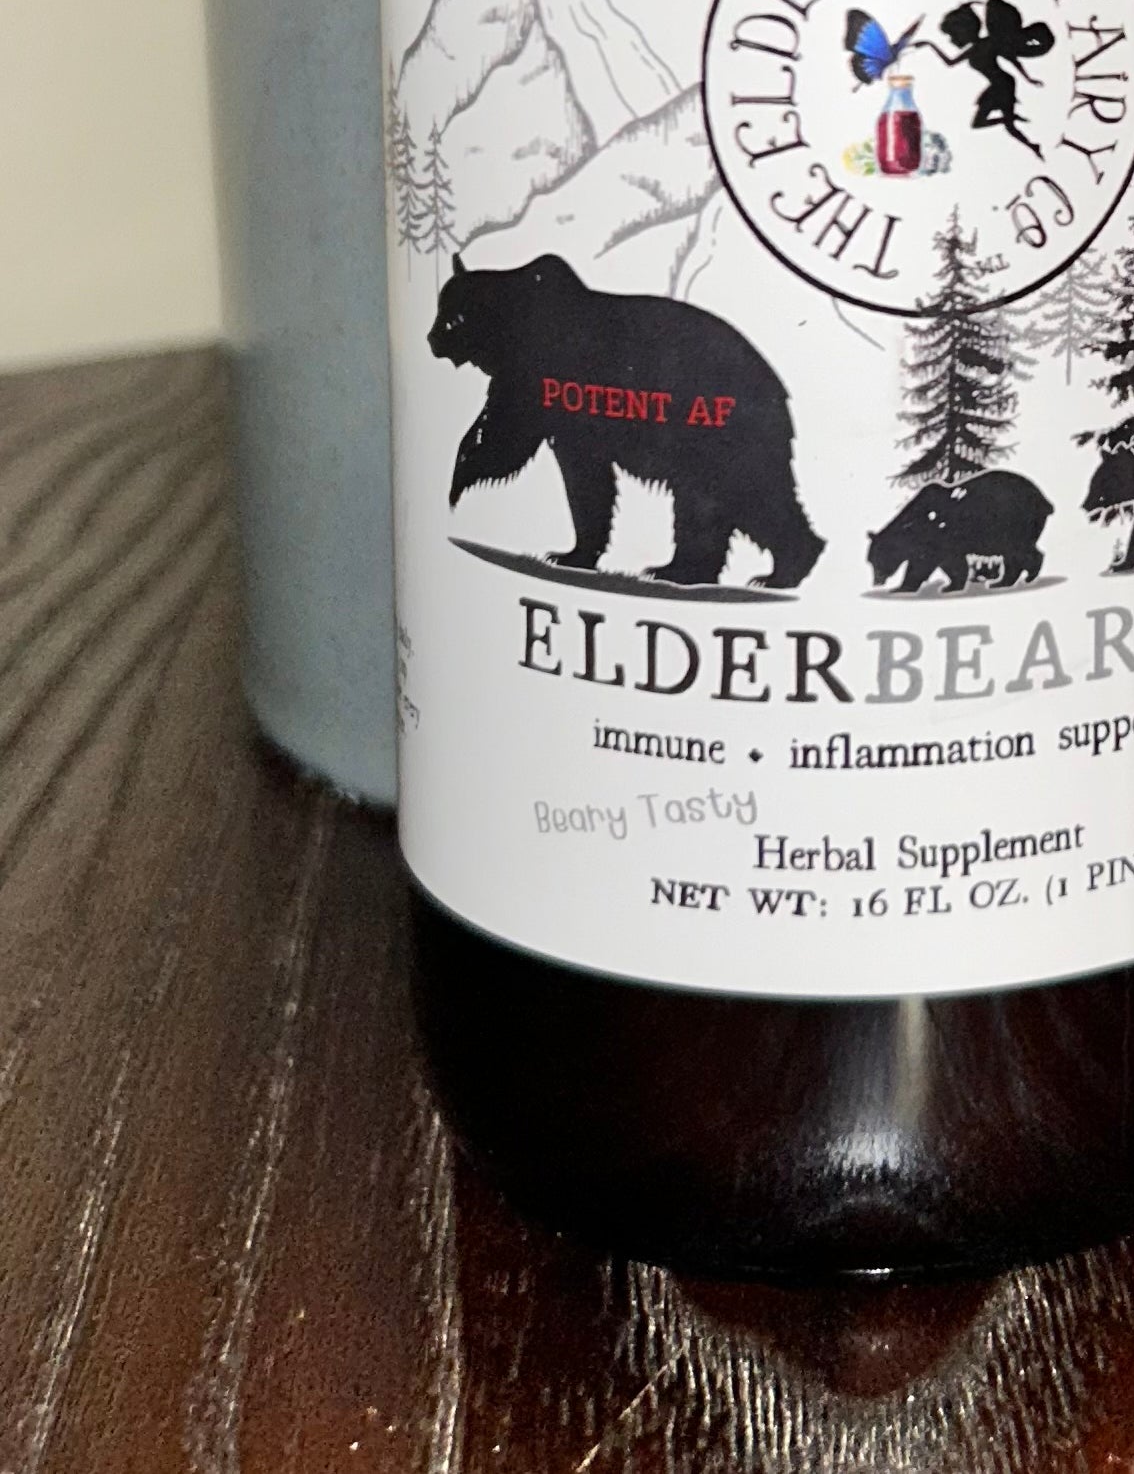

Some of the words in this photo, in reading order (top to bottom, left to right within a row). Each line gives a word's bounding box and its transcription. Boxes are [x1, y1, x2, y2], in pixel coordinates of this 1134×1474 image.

[769, 163, 902, 280] THE
[541, 377, 672, 424] POTENT
[686, 395, 736, 428] AF
[592, 718, 726, 766] immune
[788, 724, 1037, 771] inflammation
[533, 800, 628, 841] Beary
[636, 787, 759, 828] Tasty
[752, 834, 877, 872] Herbal
[897, 823, 1087, 879] Supplement
[650, 876, 731, 913] NET
[746, 887, 828, 919] WT:
[852, 888, 889, 919] 16
[903, 884, 953, 916] FL
[968, 877, 1030, 911] OZ.
